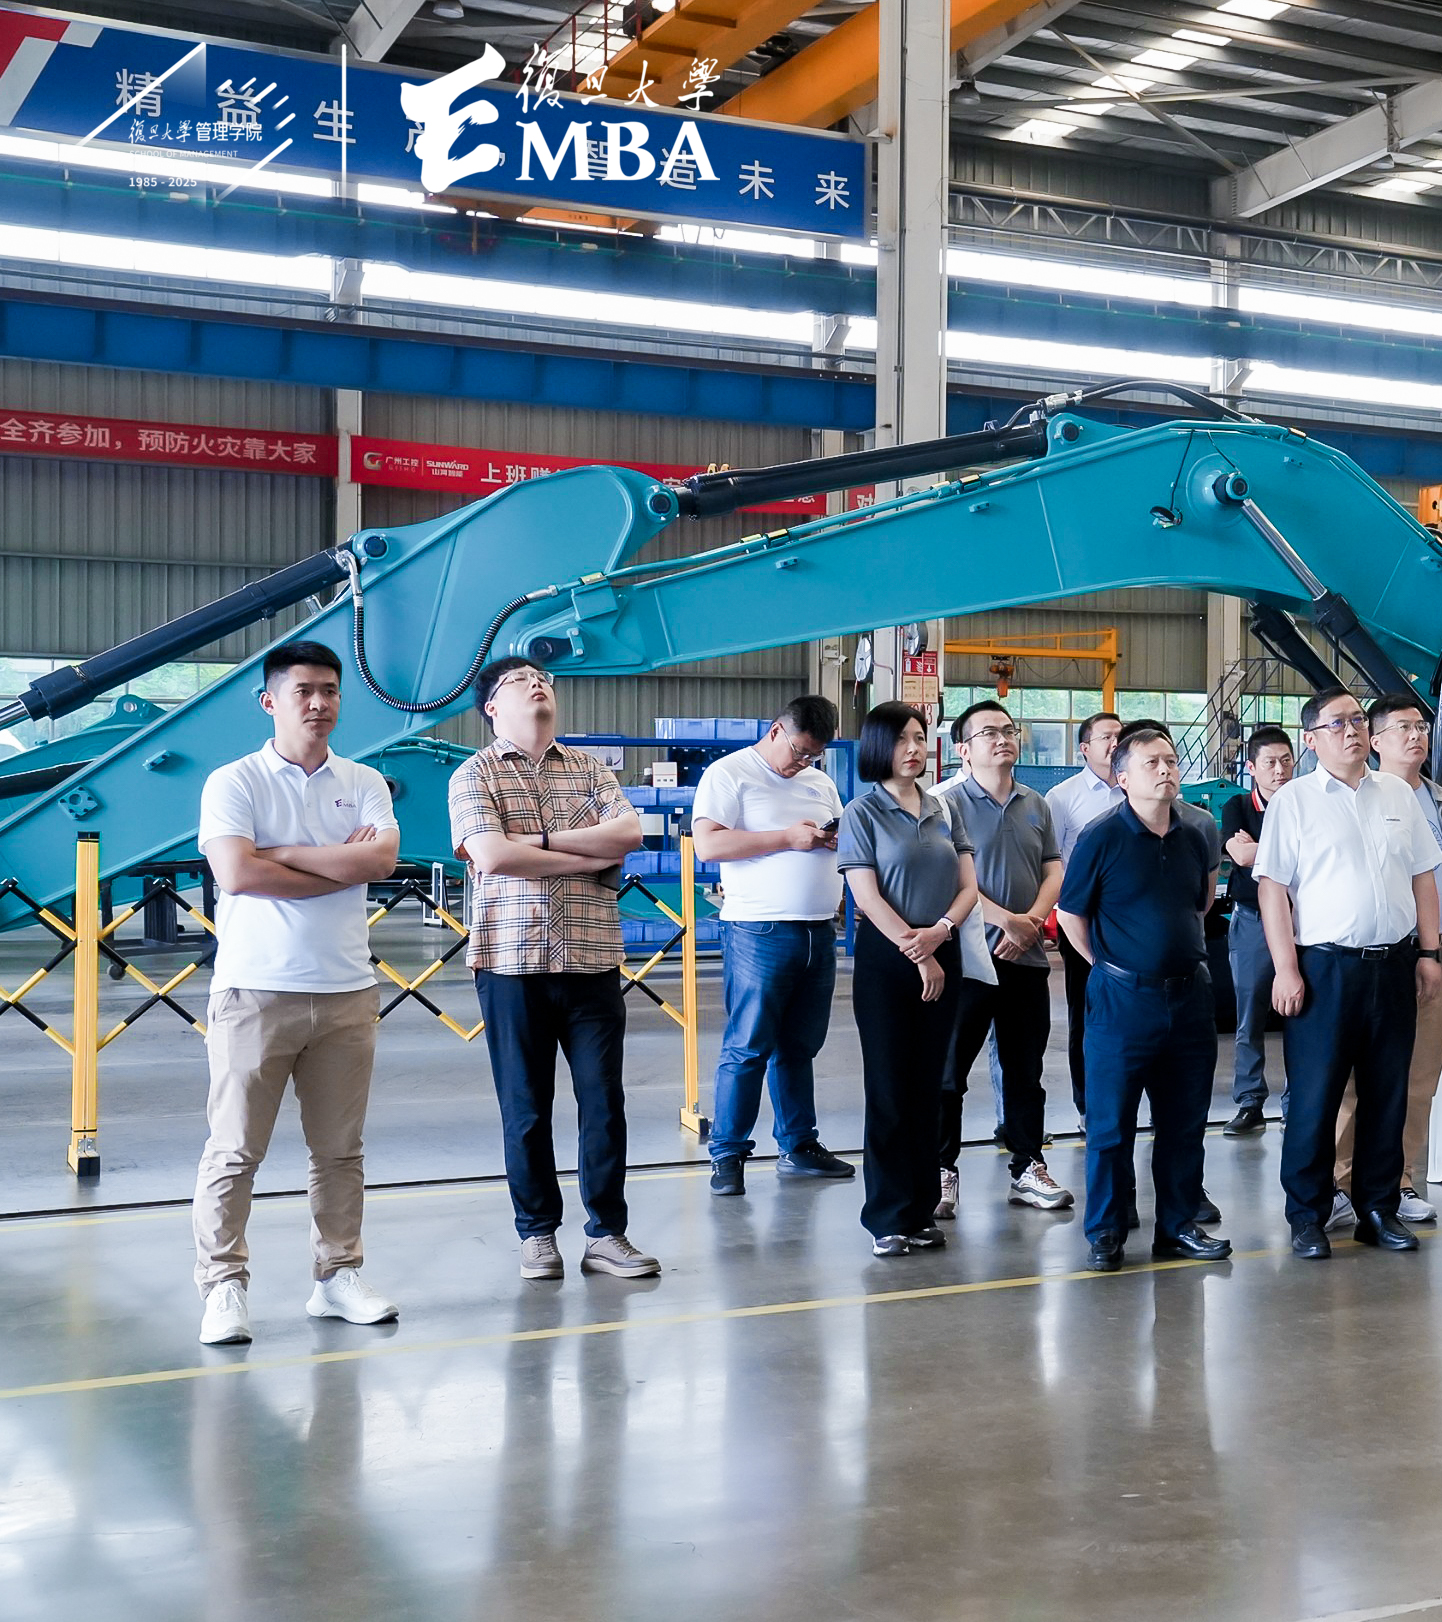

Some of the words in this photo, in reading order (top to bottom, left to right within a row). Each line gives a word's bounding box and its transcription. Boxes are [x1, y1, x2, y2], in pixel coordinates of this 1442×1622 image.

[0, 417, 317, 465] 全齐参加，预防火灾靠大家
[426, 460, 469, 471] SUNWARD
